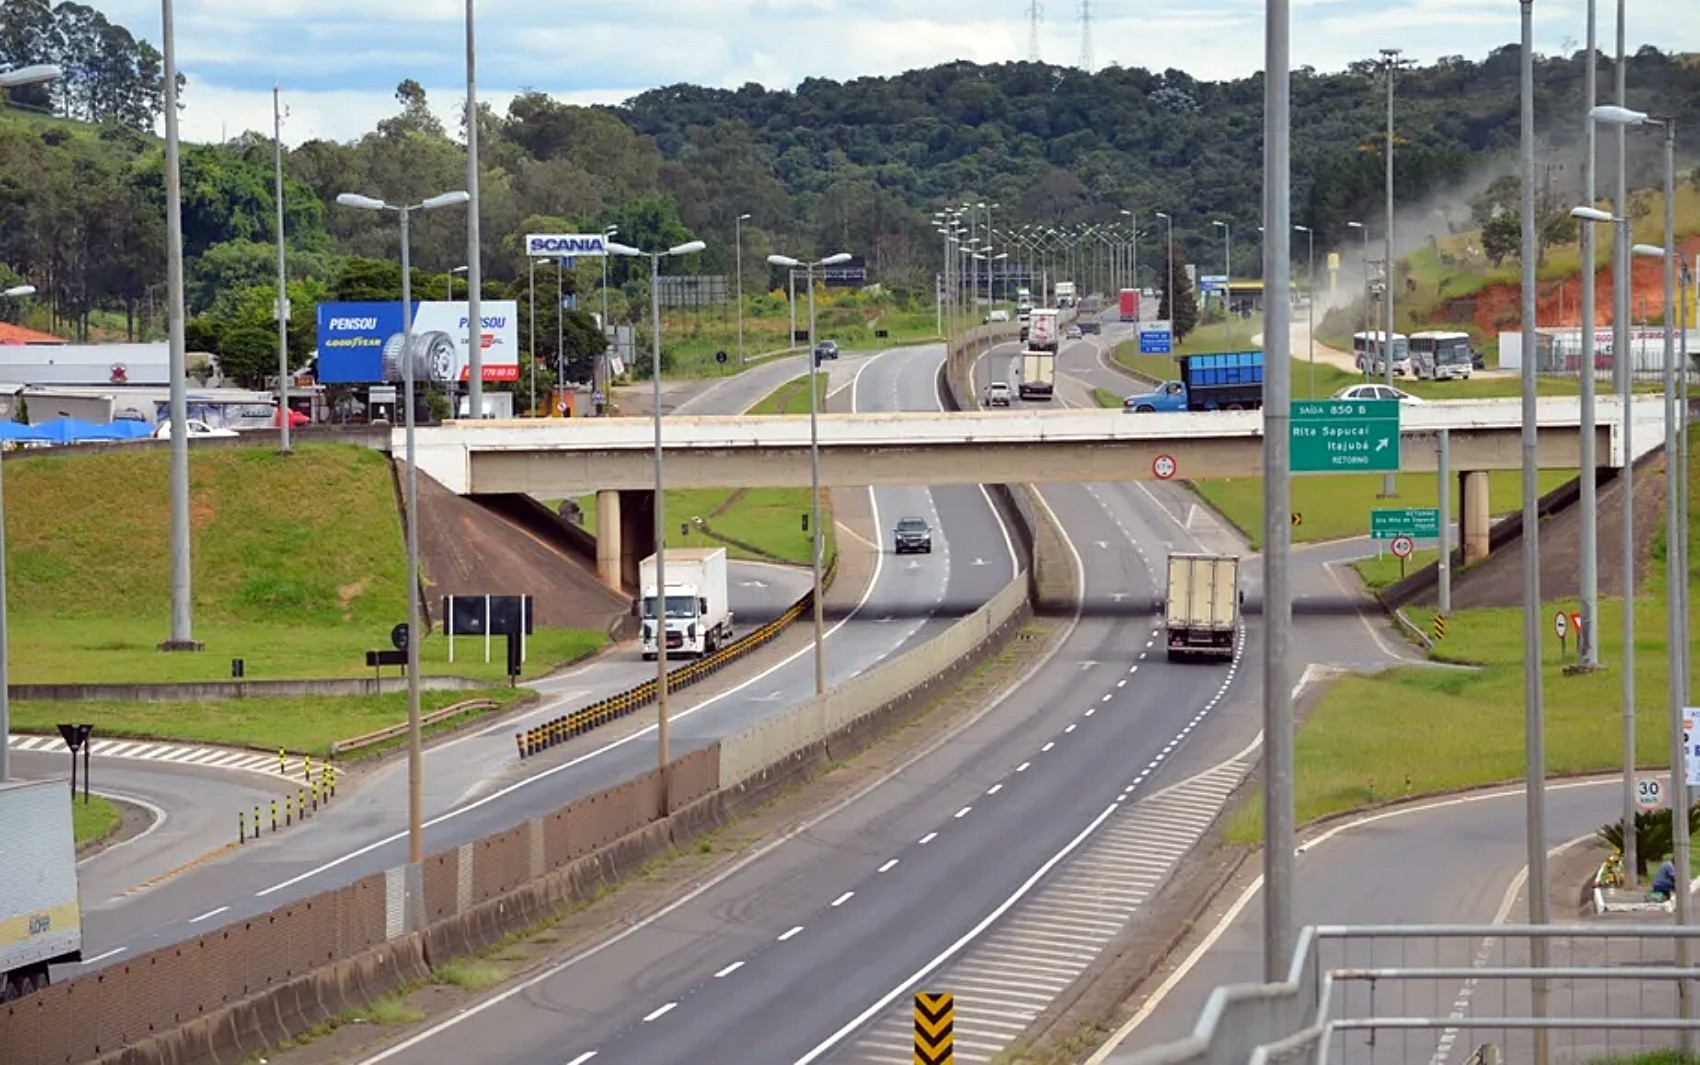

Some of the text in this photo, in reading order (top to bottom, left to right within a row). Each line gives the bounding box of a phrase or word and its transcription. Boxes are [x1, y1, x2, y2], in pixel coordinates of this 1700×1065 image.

[531, 238, 604, 251] SCANIA
[329, 318, 377, 330] PENSOU
[459, 317, 506, 328] PSOU
[326, 337, 381, 347] GOODYEAR
[1330, 405, 1353, 415] 850
[1292, 426, 1317, 436] Rita
[1327, 440, 1369, 452] Itajubá
[1331, 455, 1370, 464] RETORNO
[1396, 541, 1408, 551] 40
[1639, 782, 1658, 795] 30
